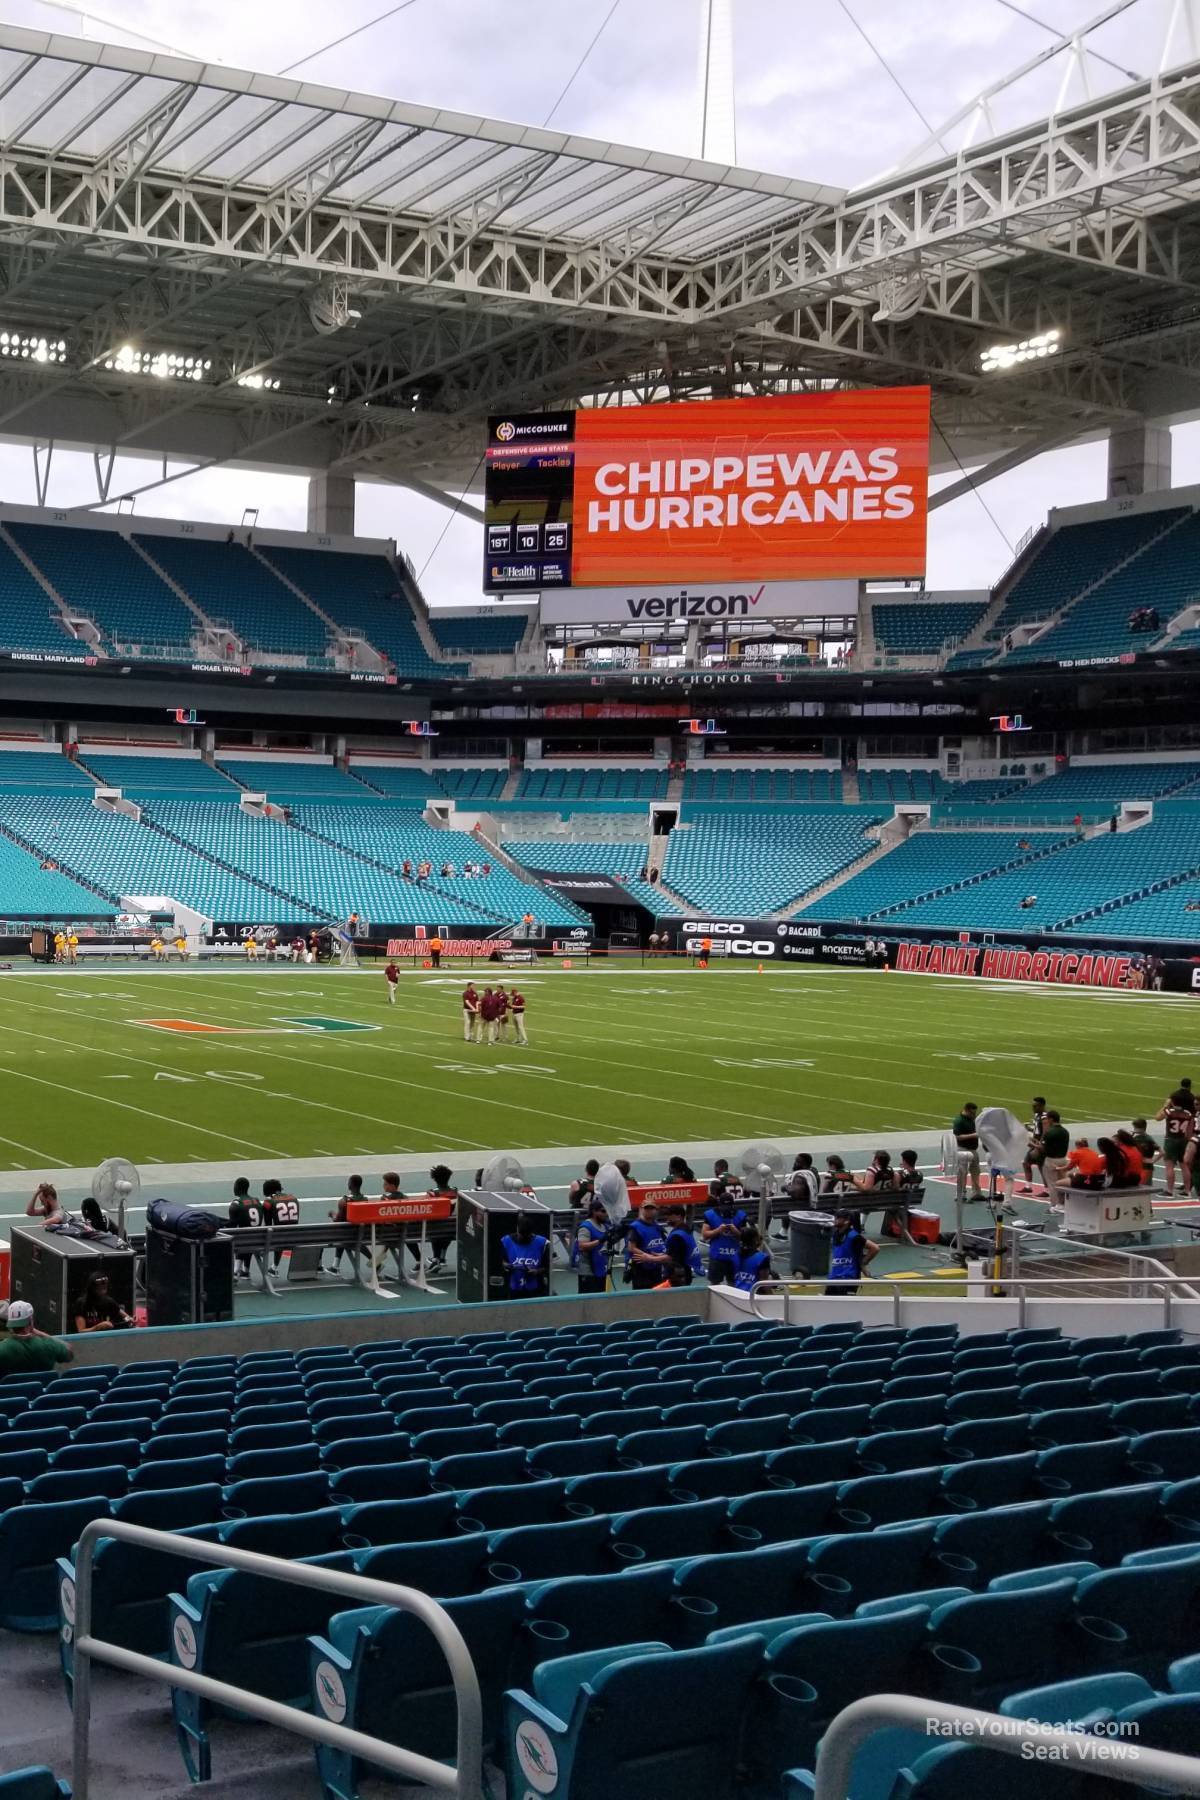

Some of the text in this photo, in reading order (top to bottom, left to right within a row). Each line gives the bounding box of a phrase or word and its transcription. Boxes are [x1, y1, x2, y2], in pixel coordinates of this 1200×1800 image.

[516, 424, 568, 434] MICCOSUKEE
[492, 458, 570, 471] Player Tackles
[595, 447, 898, 496] CHIPPEWAS
[588, 485, 915, 532] HURRICANES
[490, 538, 508, 549] 1ST
[521, 537, 534, 548] 10
[548, 535, 563, 546] 25
[627, 591, 748, 619] verizon
[11, 652, 43, 661] RUSSELL
[191, 664, 221, 672] MICHAEL
[632, 676, 673, 685] RING
[690, 674, 753, 684] HONOR
[682, 922, 745, 934] GEICO
[822, 944, 853, 955] ROCKET
[895, 943, 980, 976] MIAMI
[1169, 1119, 1190, 1134] 34
[645, 1189, 691, 1201] GATORADE
[725, 1185, 744, 1199] 52
[276, 1201, 298, 1222] 22
[378, 1204, 433, 1217] GATORADE
[248, 1207, 260, 1227] 9
